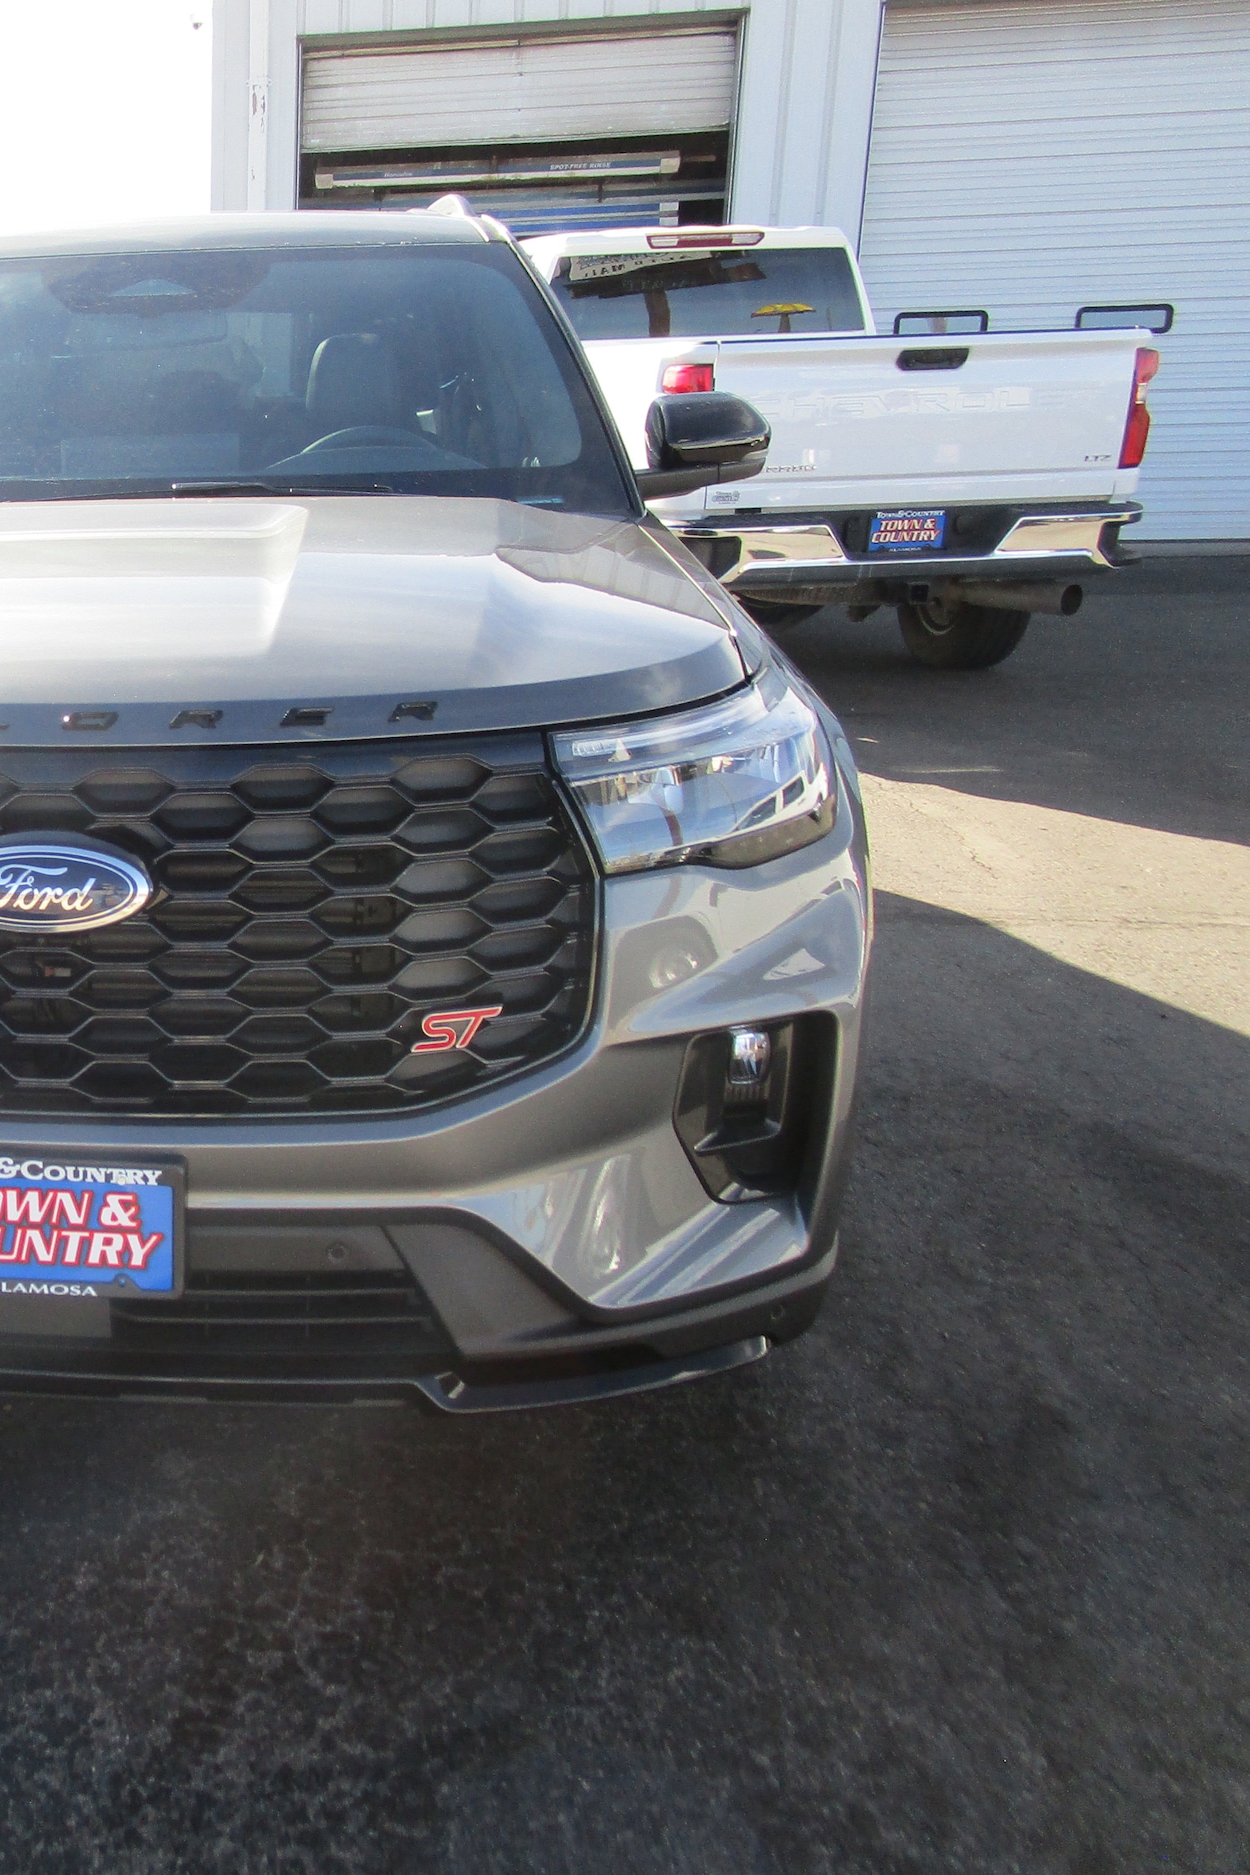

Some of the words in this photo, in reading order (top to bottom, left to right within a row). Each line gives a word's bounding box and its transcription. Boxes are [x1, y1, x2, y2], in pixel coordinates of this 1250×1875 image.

[750, 387, 1104, 419] CHEVROLE
[871, 530, 941, 543] COUNTRY
[880, 519, 922, 531] TOWN
[924, 518, 937, 530] &
[411, 1005, 503, 1053] ST
[99, 1190, 141, 1231] &
